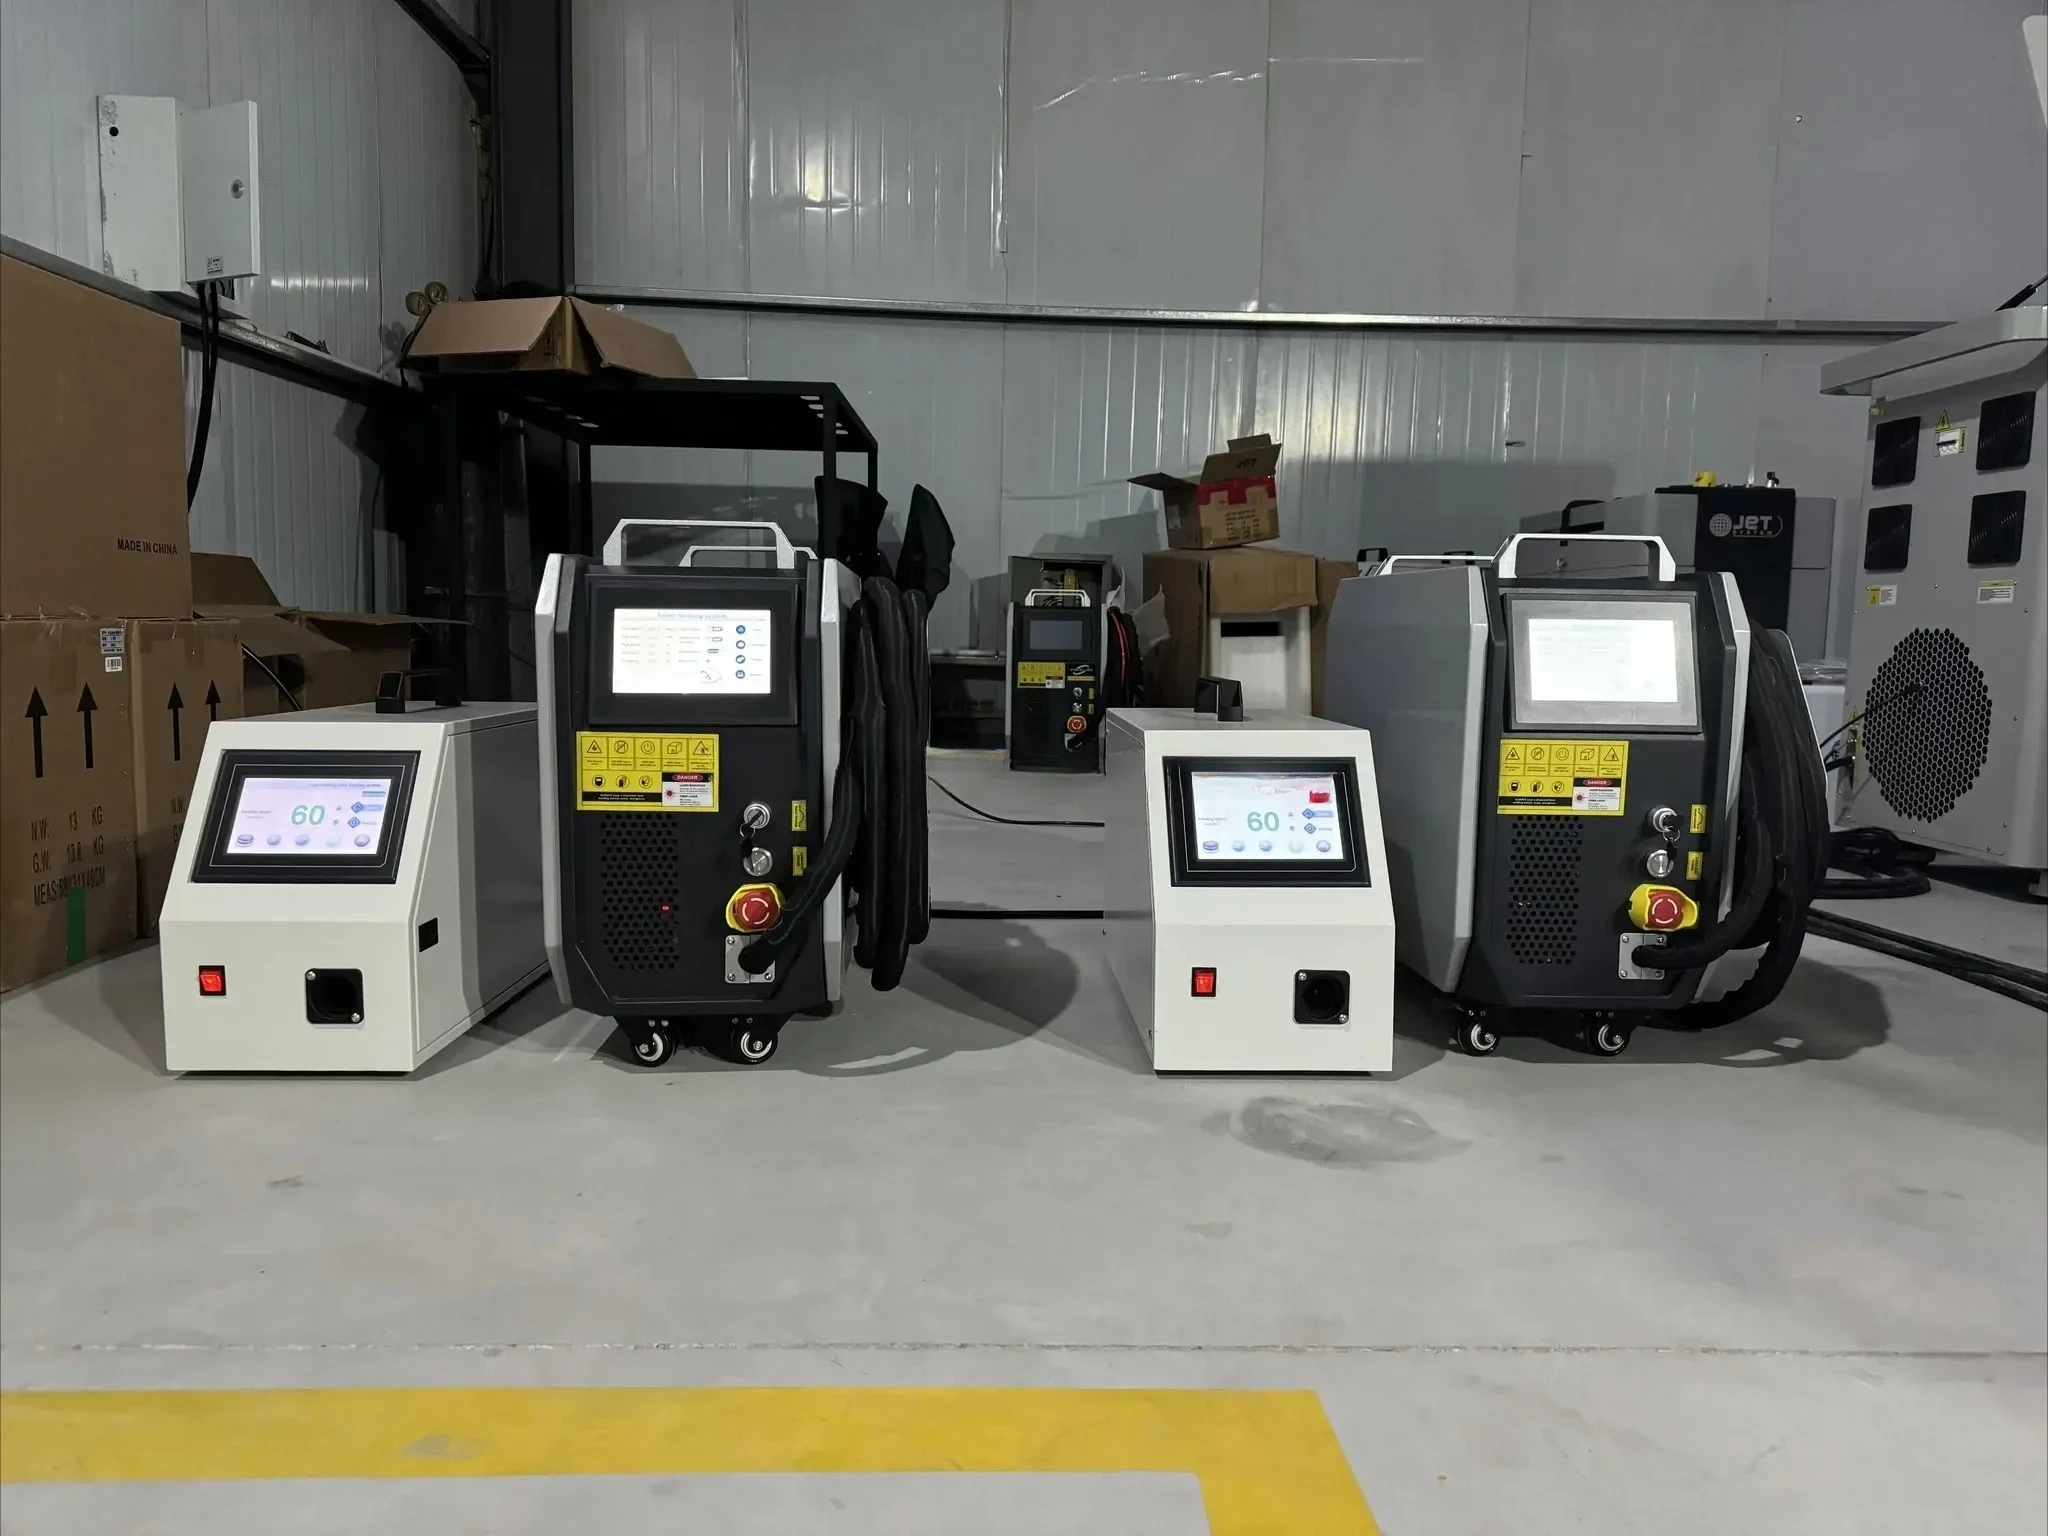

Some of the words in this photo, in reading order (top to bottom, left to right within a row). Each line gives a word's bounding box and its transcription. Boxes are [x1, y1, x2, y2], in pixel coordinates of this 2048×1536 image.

[117, 538, 142, 552] MADE
[142, 541, 152, 553] IN
[152, 542, 178, 555] CHINA
[31, 817, 50, 841] N.W:
[69, 811, 78, 831] 13
[92, 805, 103, 827] KG
[290, 804, 326, 826] 60
[1247, 811, 1280, 832] 60
[32, 849, 52, 873] G.W:
[93, 835, 104, 856] KG
